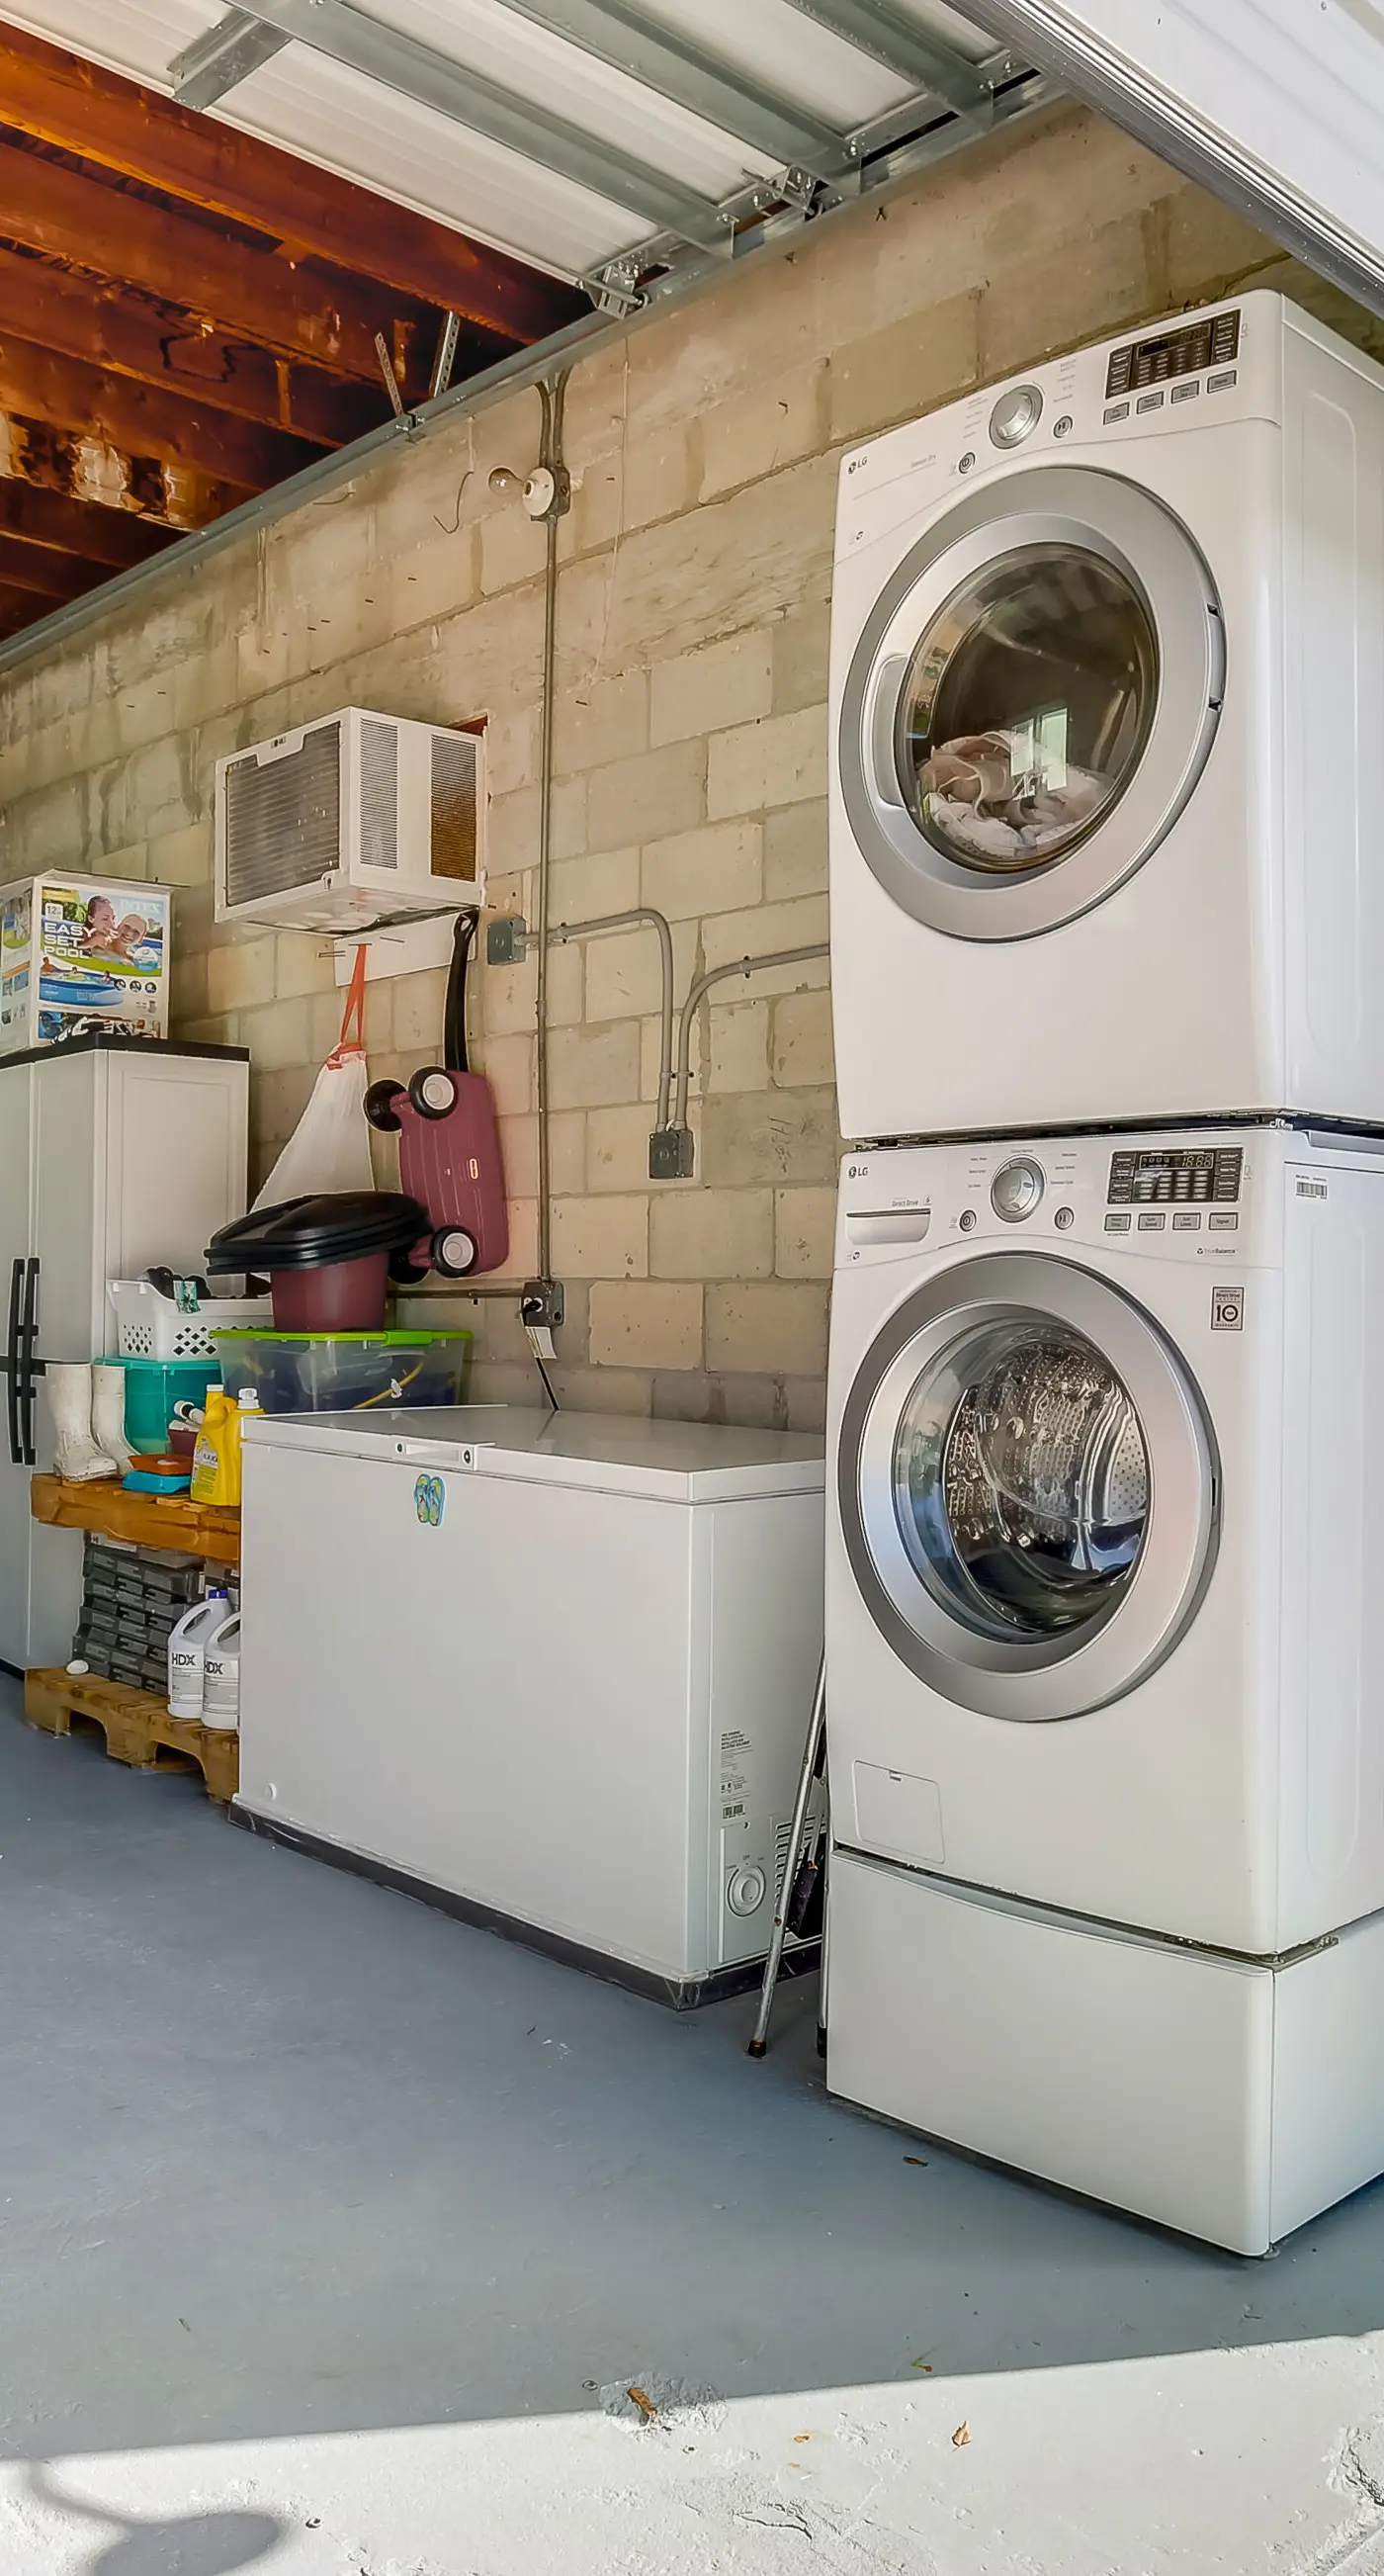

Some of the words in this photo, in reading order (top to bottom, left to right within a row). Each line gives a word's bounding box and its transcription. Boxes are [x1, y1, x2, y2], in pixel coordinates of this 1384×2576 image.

[46, 905, 57, 915] 12
[43, 922, 97, 937] EASY
[43, 933, 85, 948] SET
[43, 945, 91, 960] POOL
[1216, 1304, 1239, 1322] 10
[171, 1652, 196, 1666] HDX
